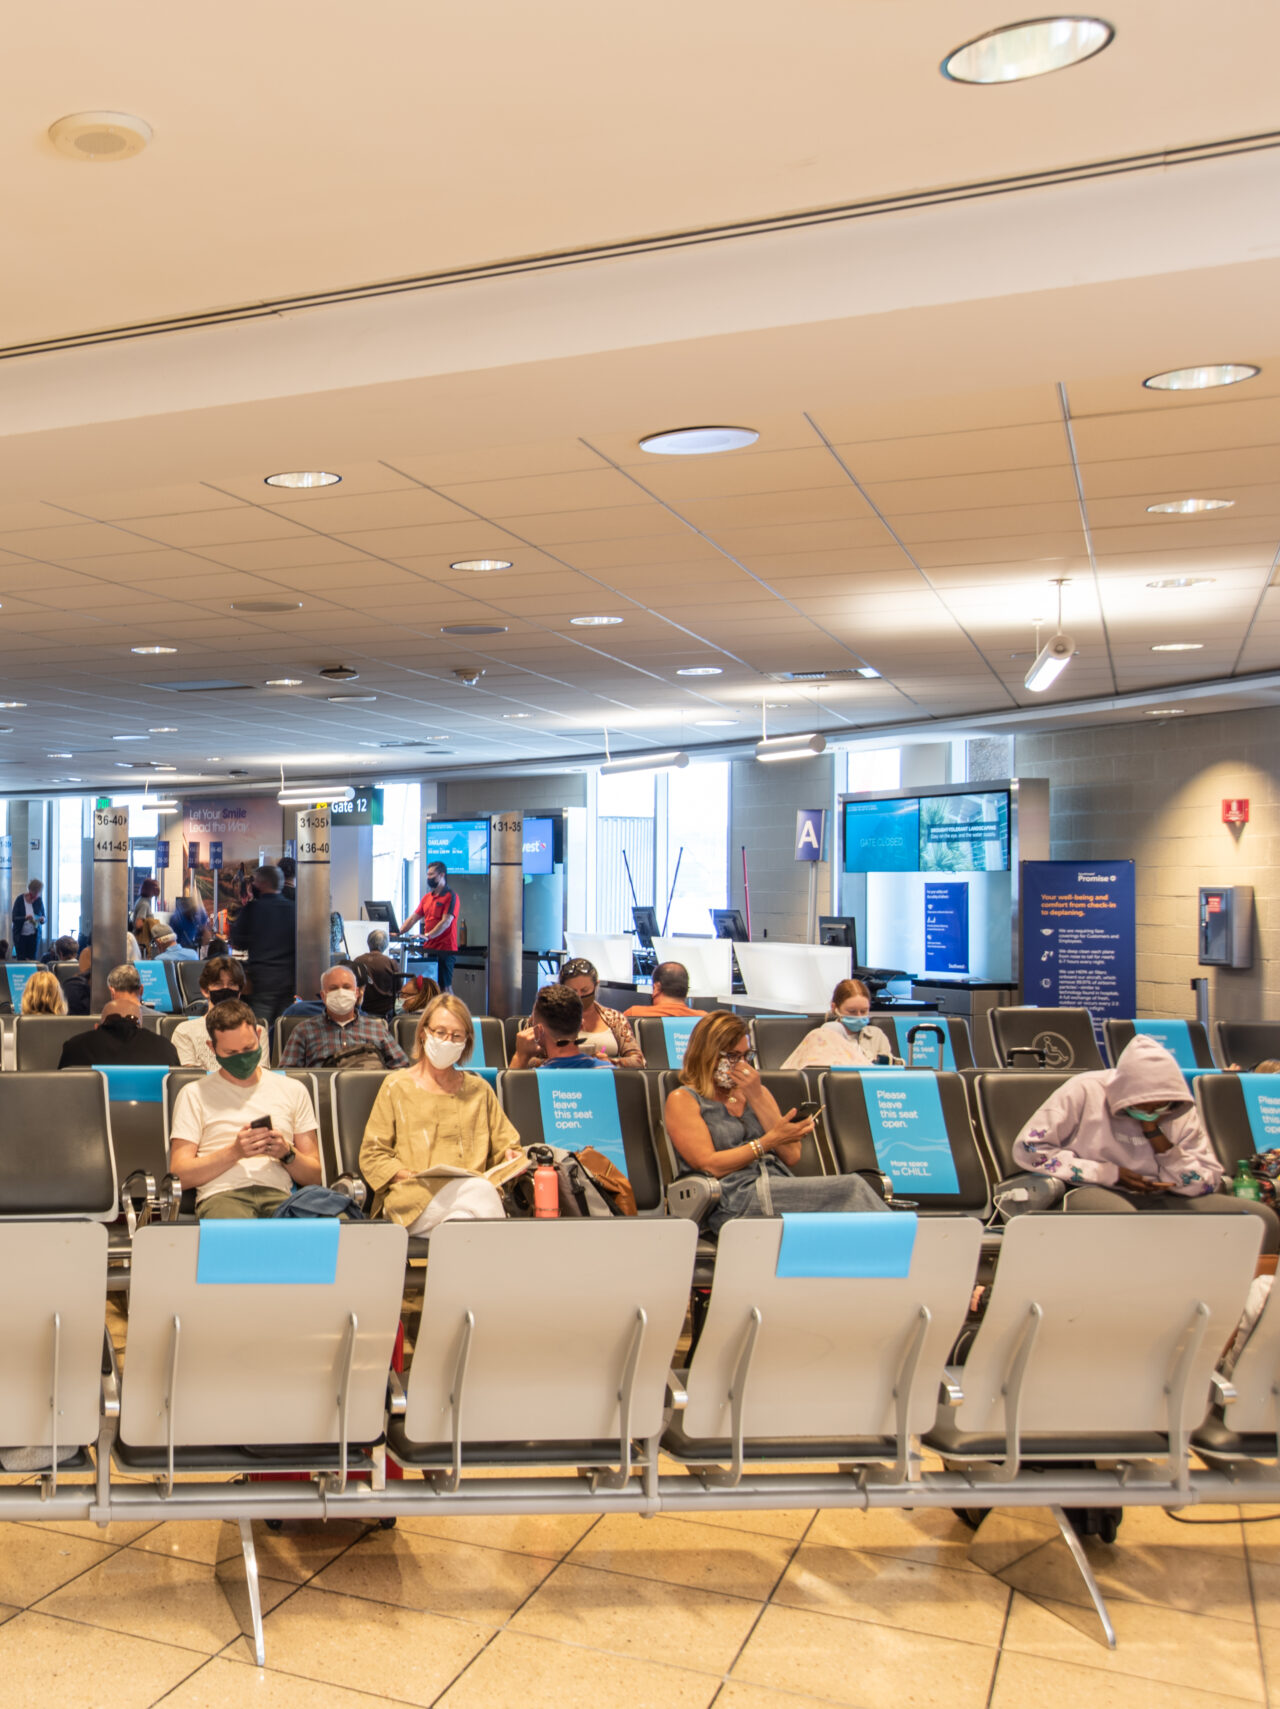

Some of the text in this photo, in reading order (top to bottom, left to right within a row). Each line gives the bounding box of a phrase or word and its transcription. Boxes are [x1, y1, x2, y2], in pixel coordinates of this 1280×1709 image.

[331, 798, 367, 813] Gate 12
[202, 808, 220, 820] Your
[222, 808, 246, 819] Smile
[97, 814, 123, 826] 36-40
[300, 818, 324, 828] 31-35
[190, 822, 210, 832] Lead
[212, 822, 226, 832] the
[498, 822, 522, 832] 31-35
[798, 820, 818, 848] A
[102, 841, 128, 852] 41-45
[306, 842, 330, 853] 36-40
[860, 838, 876, 848] GATE
[1050, 910, 1085, 918] deplaning.
[552, 1090, 582, 1099] Please
[876, 1090, 906, 1099] Please
[553, 1101, 577, 1109] leave
[879, 1101, 902, 1109] leave
[554, 1110, 593, 1119] this seat
[880, 1110, 918, 1119] this seat
[555, 1121, 582, 1130] open.
[901, 1168, 932, 1176] CHILL.
